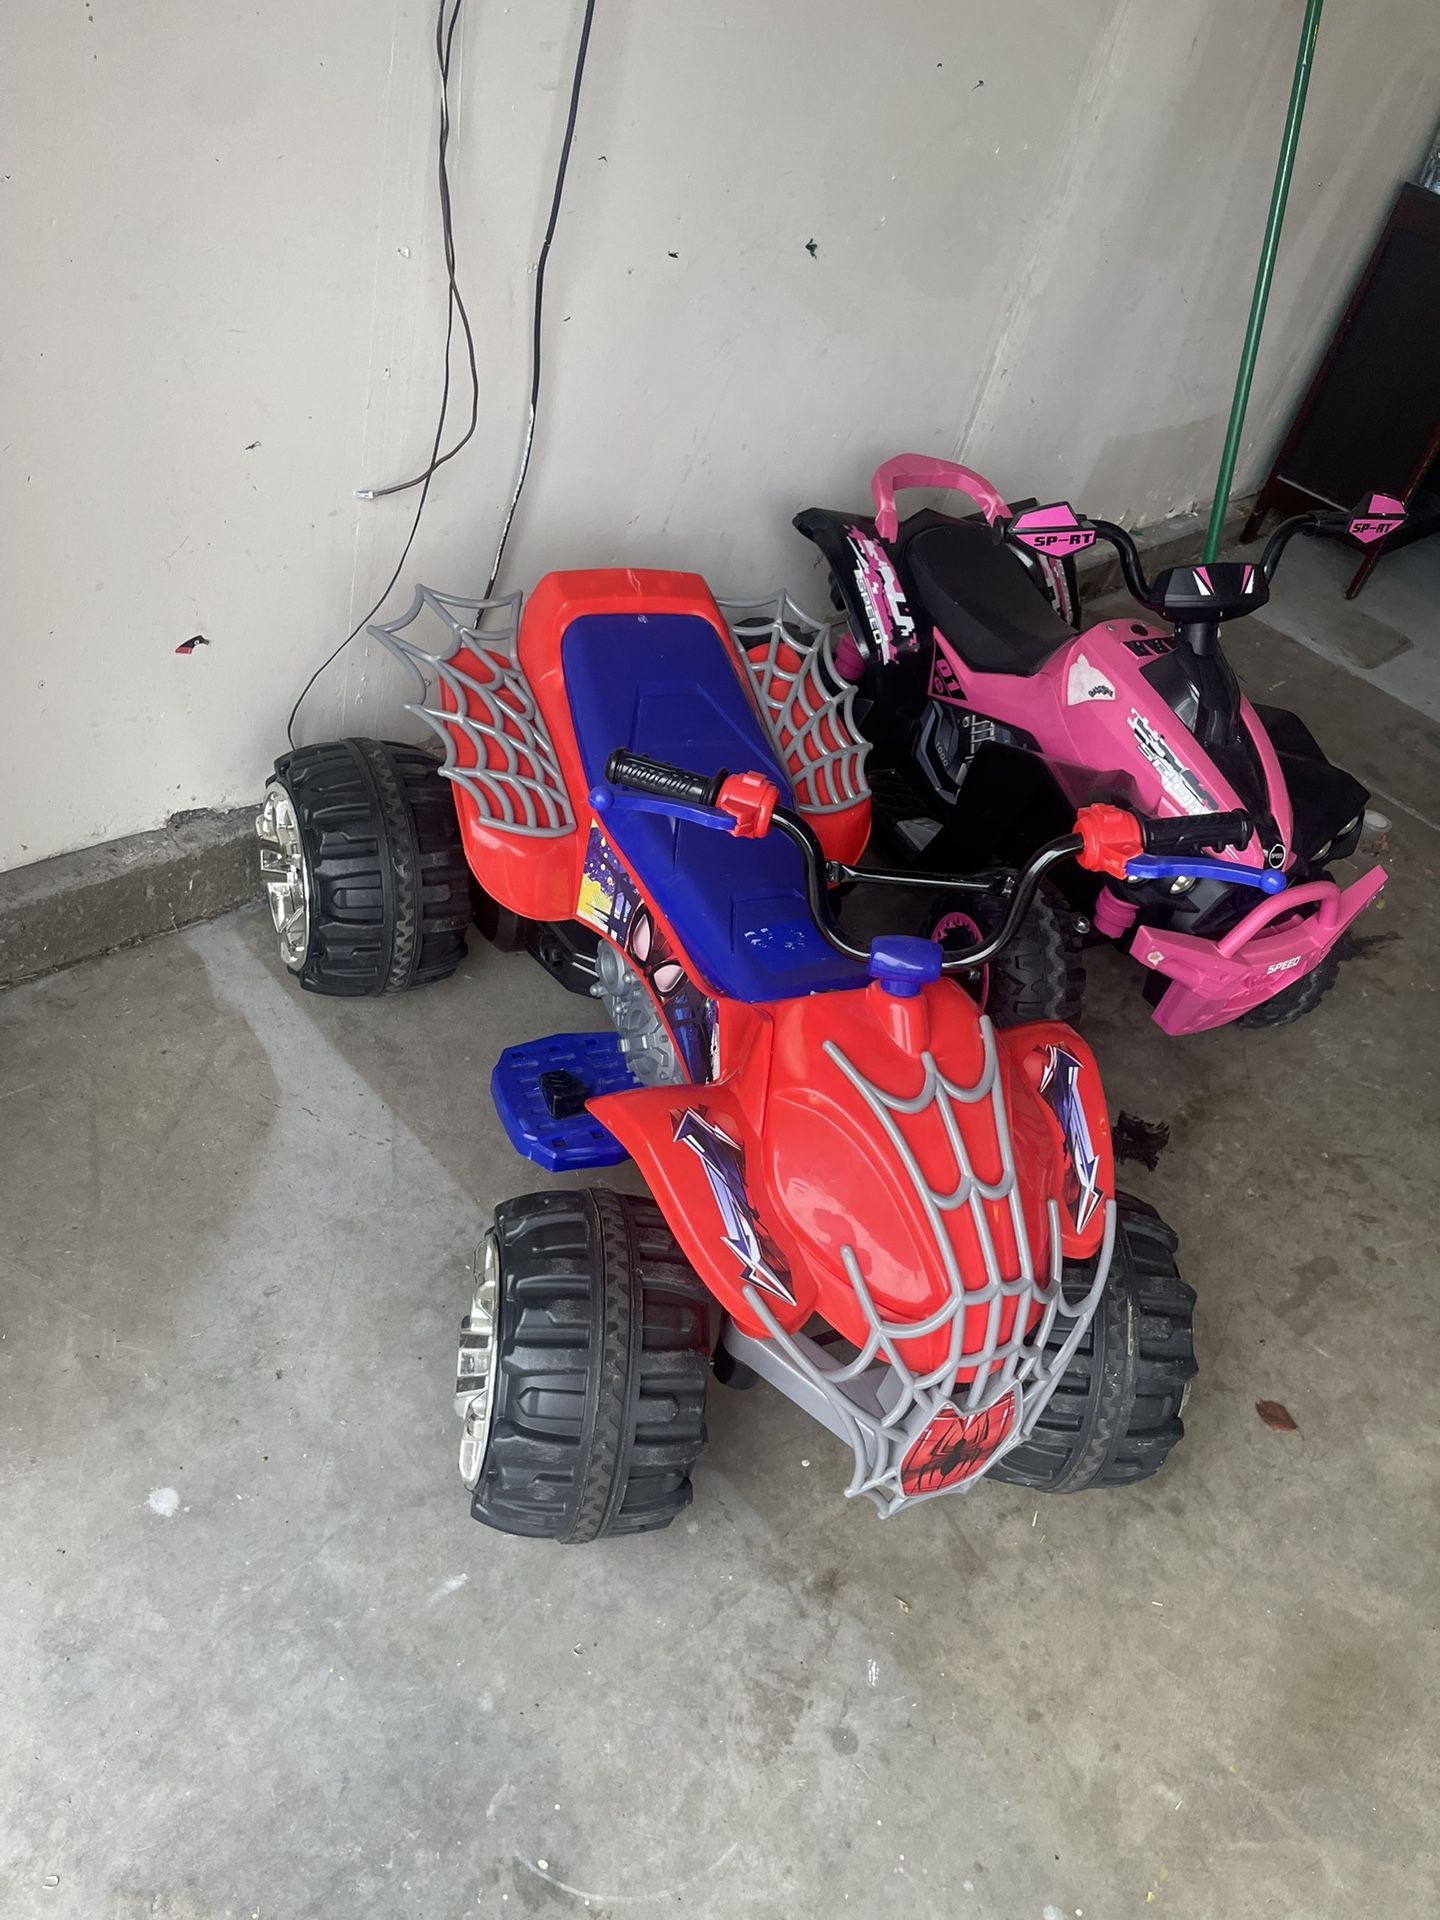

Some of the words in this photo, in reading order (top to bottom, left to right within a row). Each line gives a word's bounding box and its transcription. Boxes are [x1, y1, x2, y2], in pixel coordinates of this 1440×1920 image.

[1352, 523, 1393, 533] SP-RT
[1034, 533, 1093, 547] SP-RT
[856, 576, 882, 645] SPEED
[1266, 955, 1302, 975] SPEED
